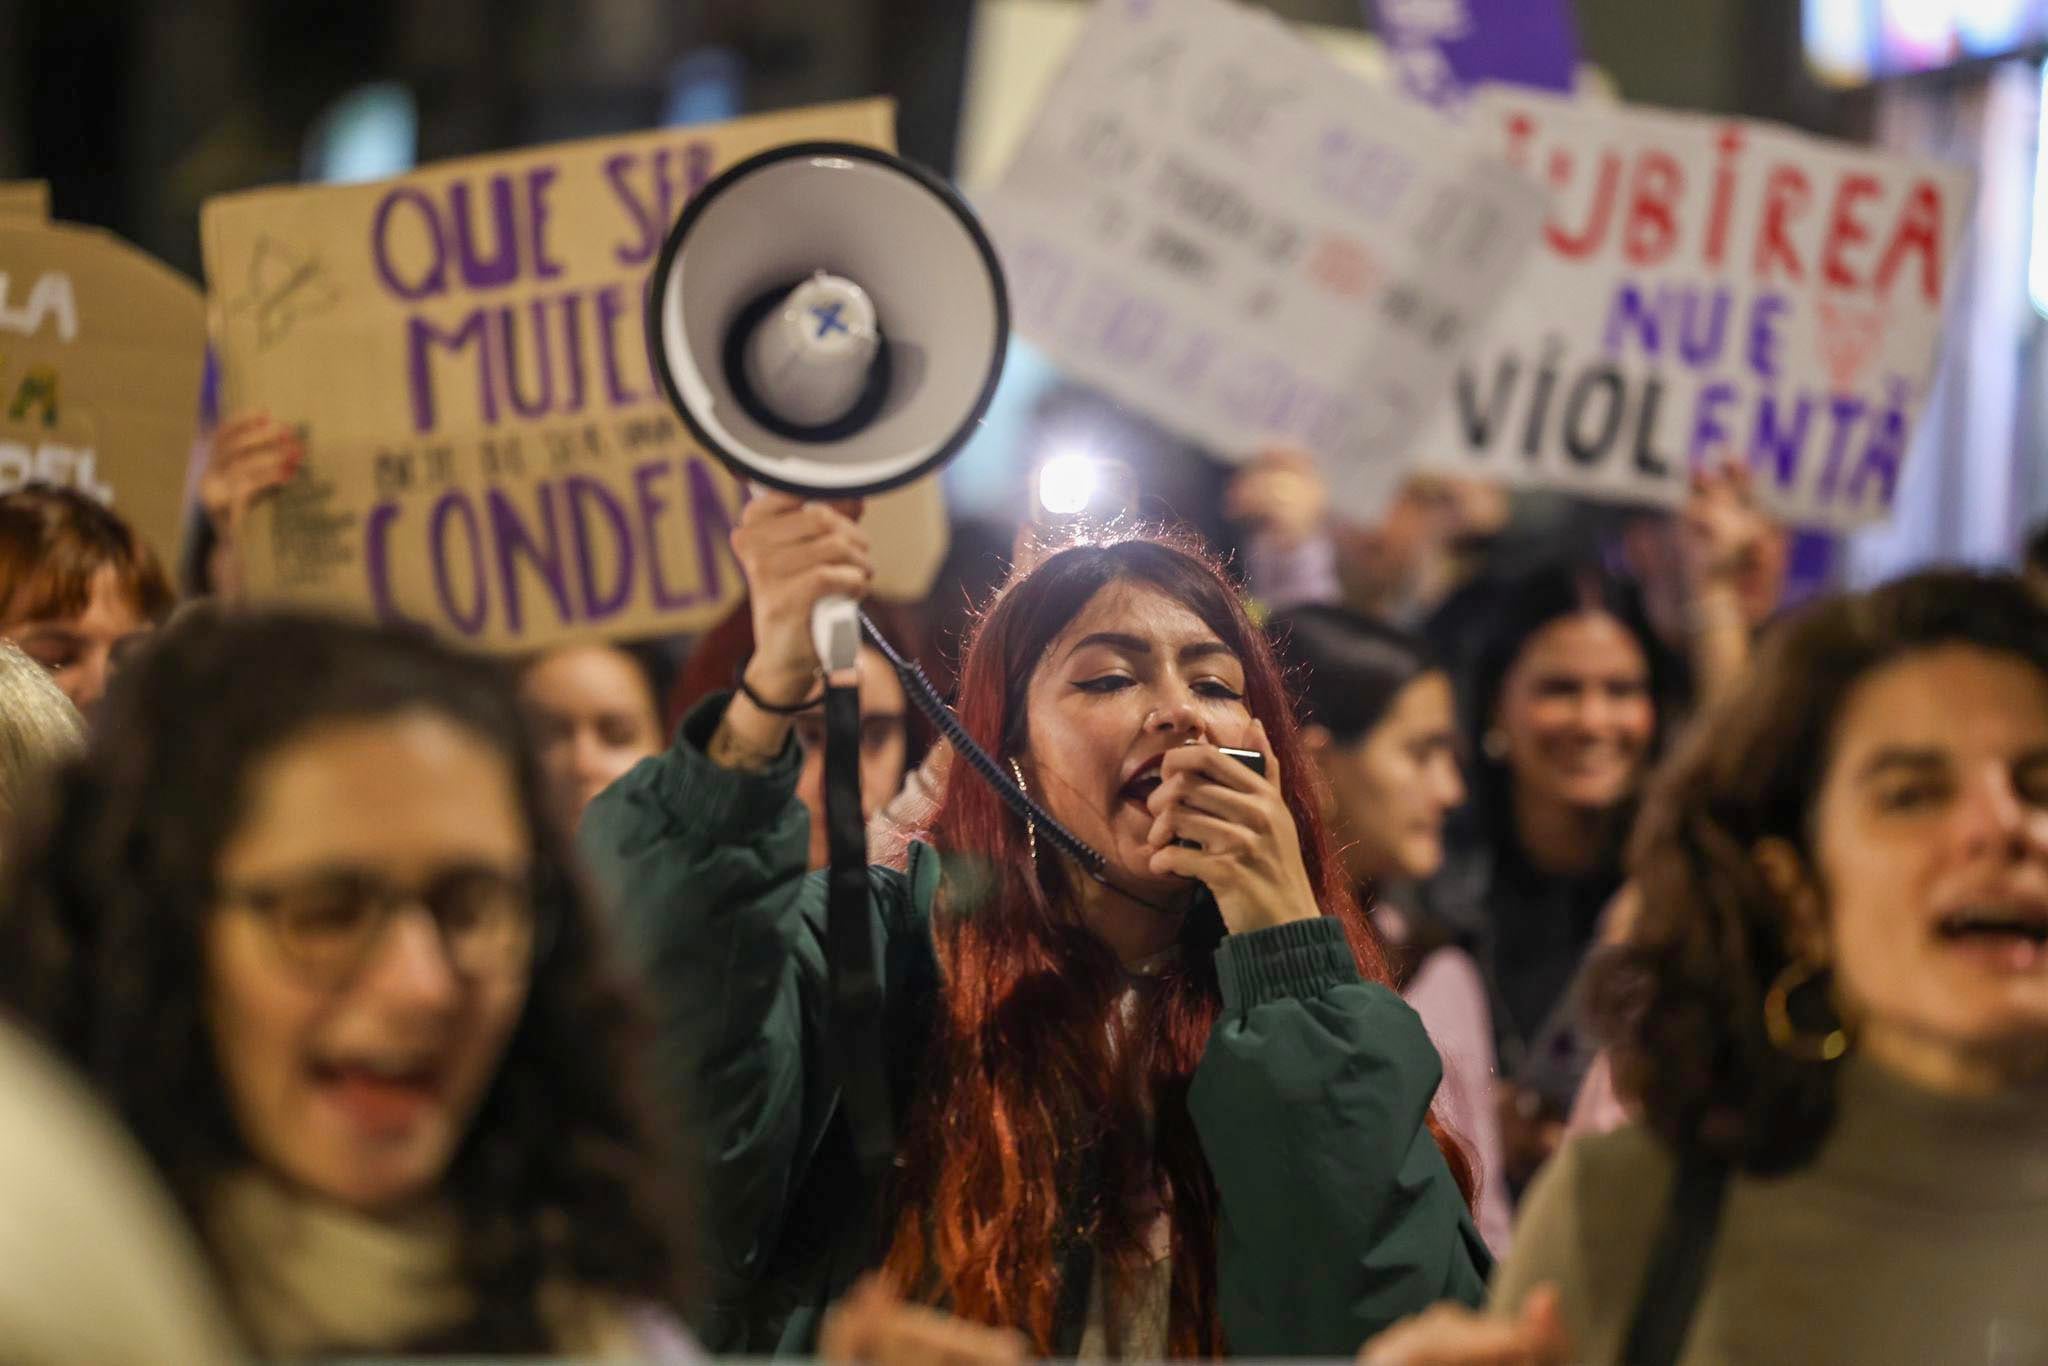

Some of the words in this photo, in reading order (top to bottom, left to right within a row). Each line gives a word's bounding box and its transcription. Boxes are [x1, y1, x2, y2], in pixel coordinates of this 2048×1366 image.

[372, 166, 566, 300] QUE
[407, 278, 664, 435] MUJE
[366, 456, 752, 636] CONDEN
